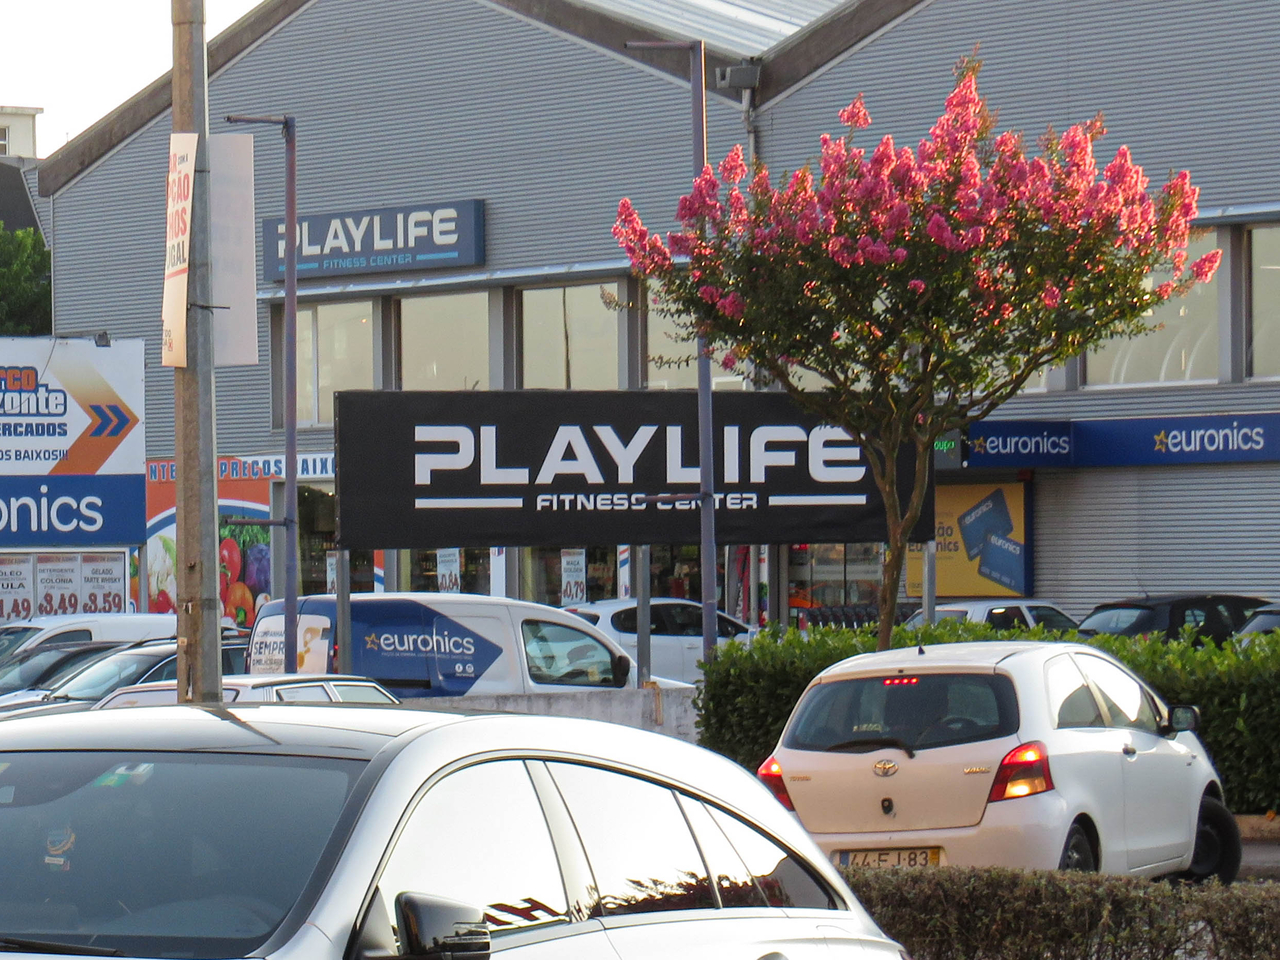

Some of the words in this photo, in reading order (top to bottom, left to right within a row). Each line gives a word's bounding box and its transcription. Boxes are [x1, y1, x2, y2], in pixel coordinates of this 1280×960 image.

[278, 208, 458, 258] PLAYLIFE
[323, 257, 366, 269] FITNESS
[370, 253, 412, 266] CENTER
[986, 432, 1069, 454] euronics
[1168, 422, 1264, 452] euronics
[415, 425, 866, 484] PLAYLIFE
[220, 460, 283, 480] PREÇOS
[297, 458, 336, 475] AIX
[908, 538, 959, 552] Eunics
[990, 535, 1020, 555] euronics
[253, 641, 286, 655] SEMPR
[380, 631, 475, 654] euronics
